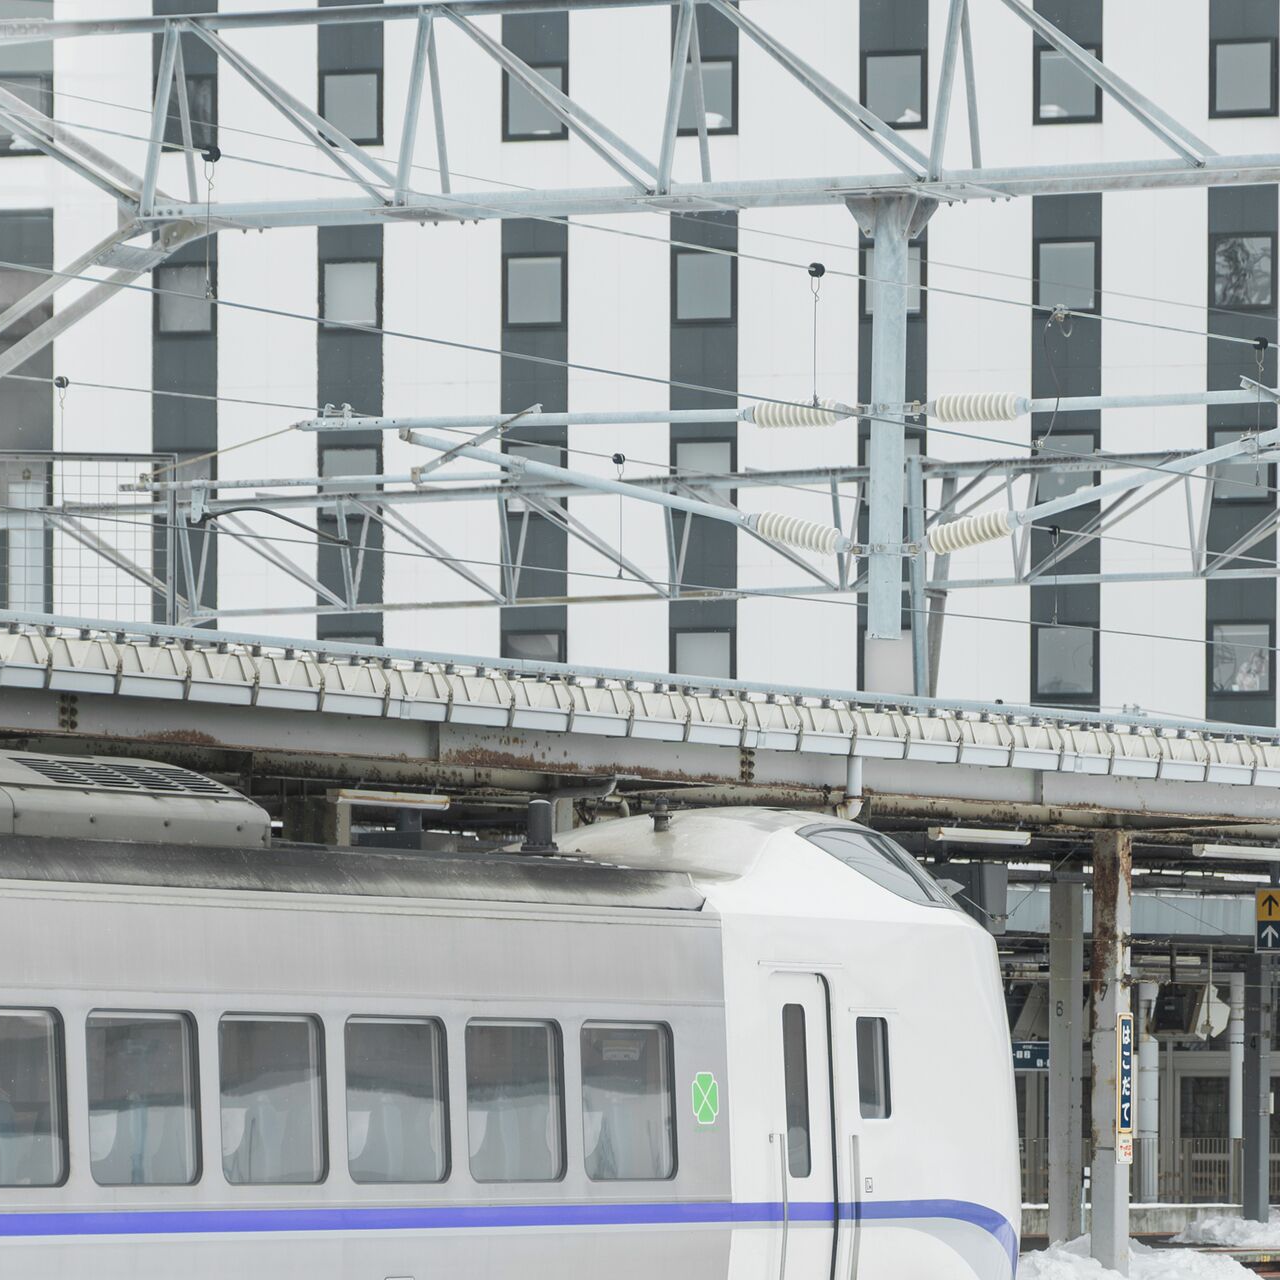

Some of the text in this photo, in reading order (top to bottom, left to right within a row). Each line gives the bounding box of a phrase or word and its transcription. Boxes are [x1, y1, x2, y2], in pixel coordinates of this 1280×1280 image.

[1055, 1000, 1064, 1017] 6
[1121, 1024, 1131, 1122] はこだて
